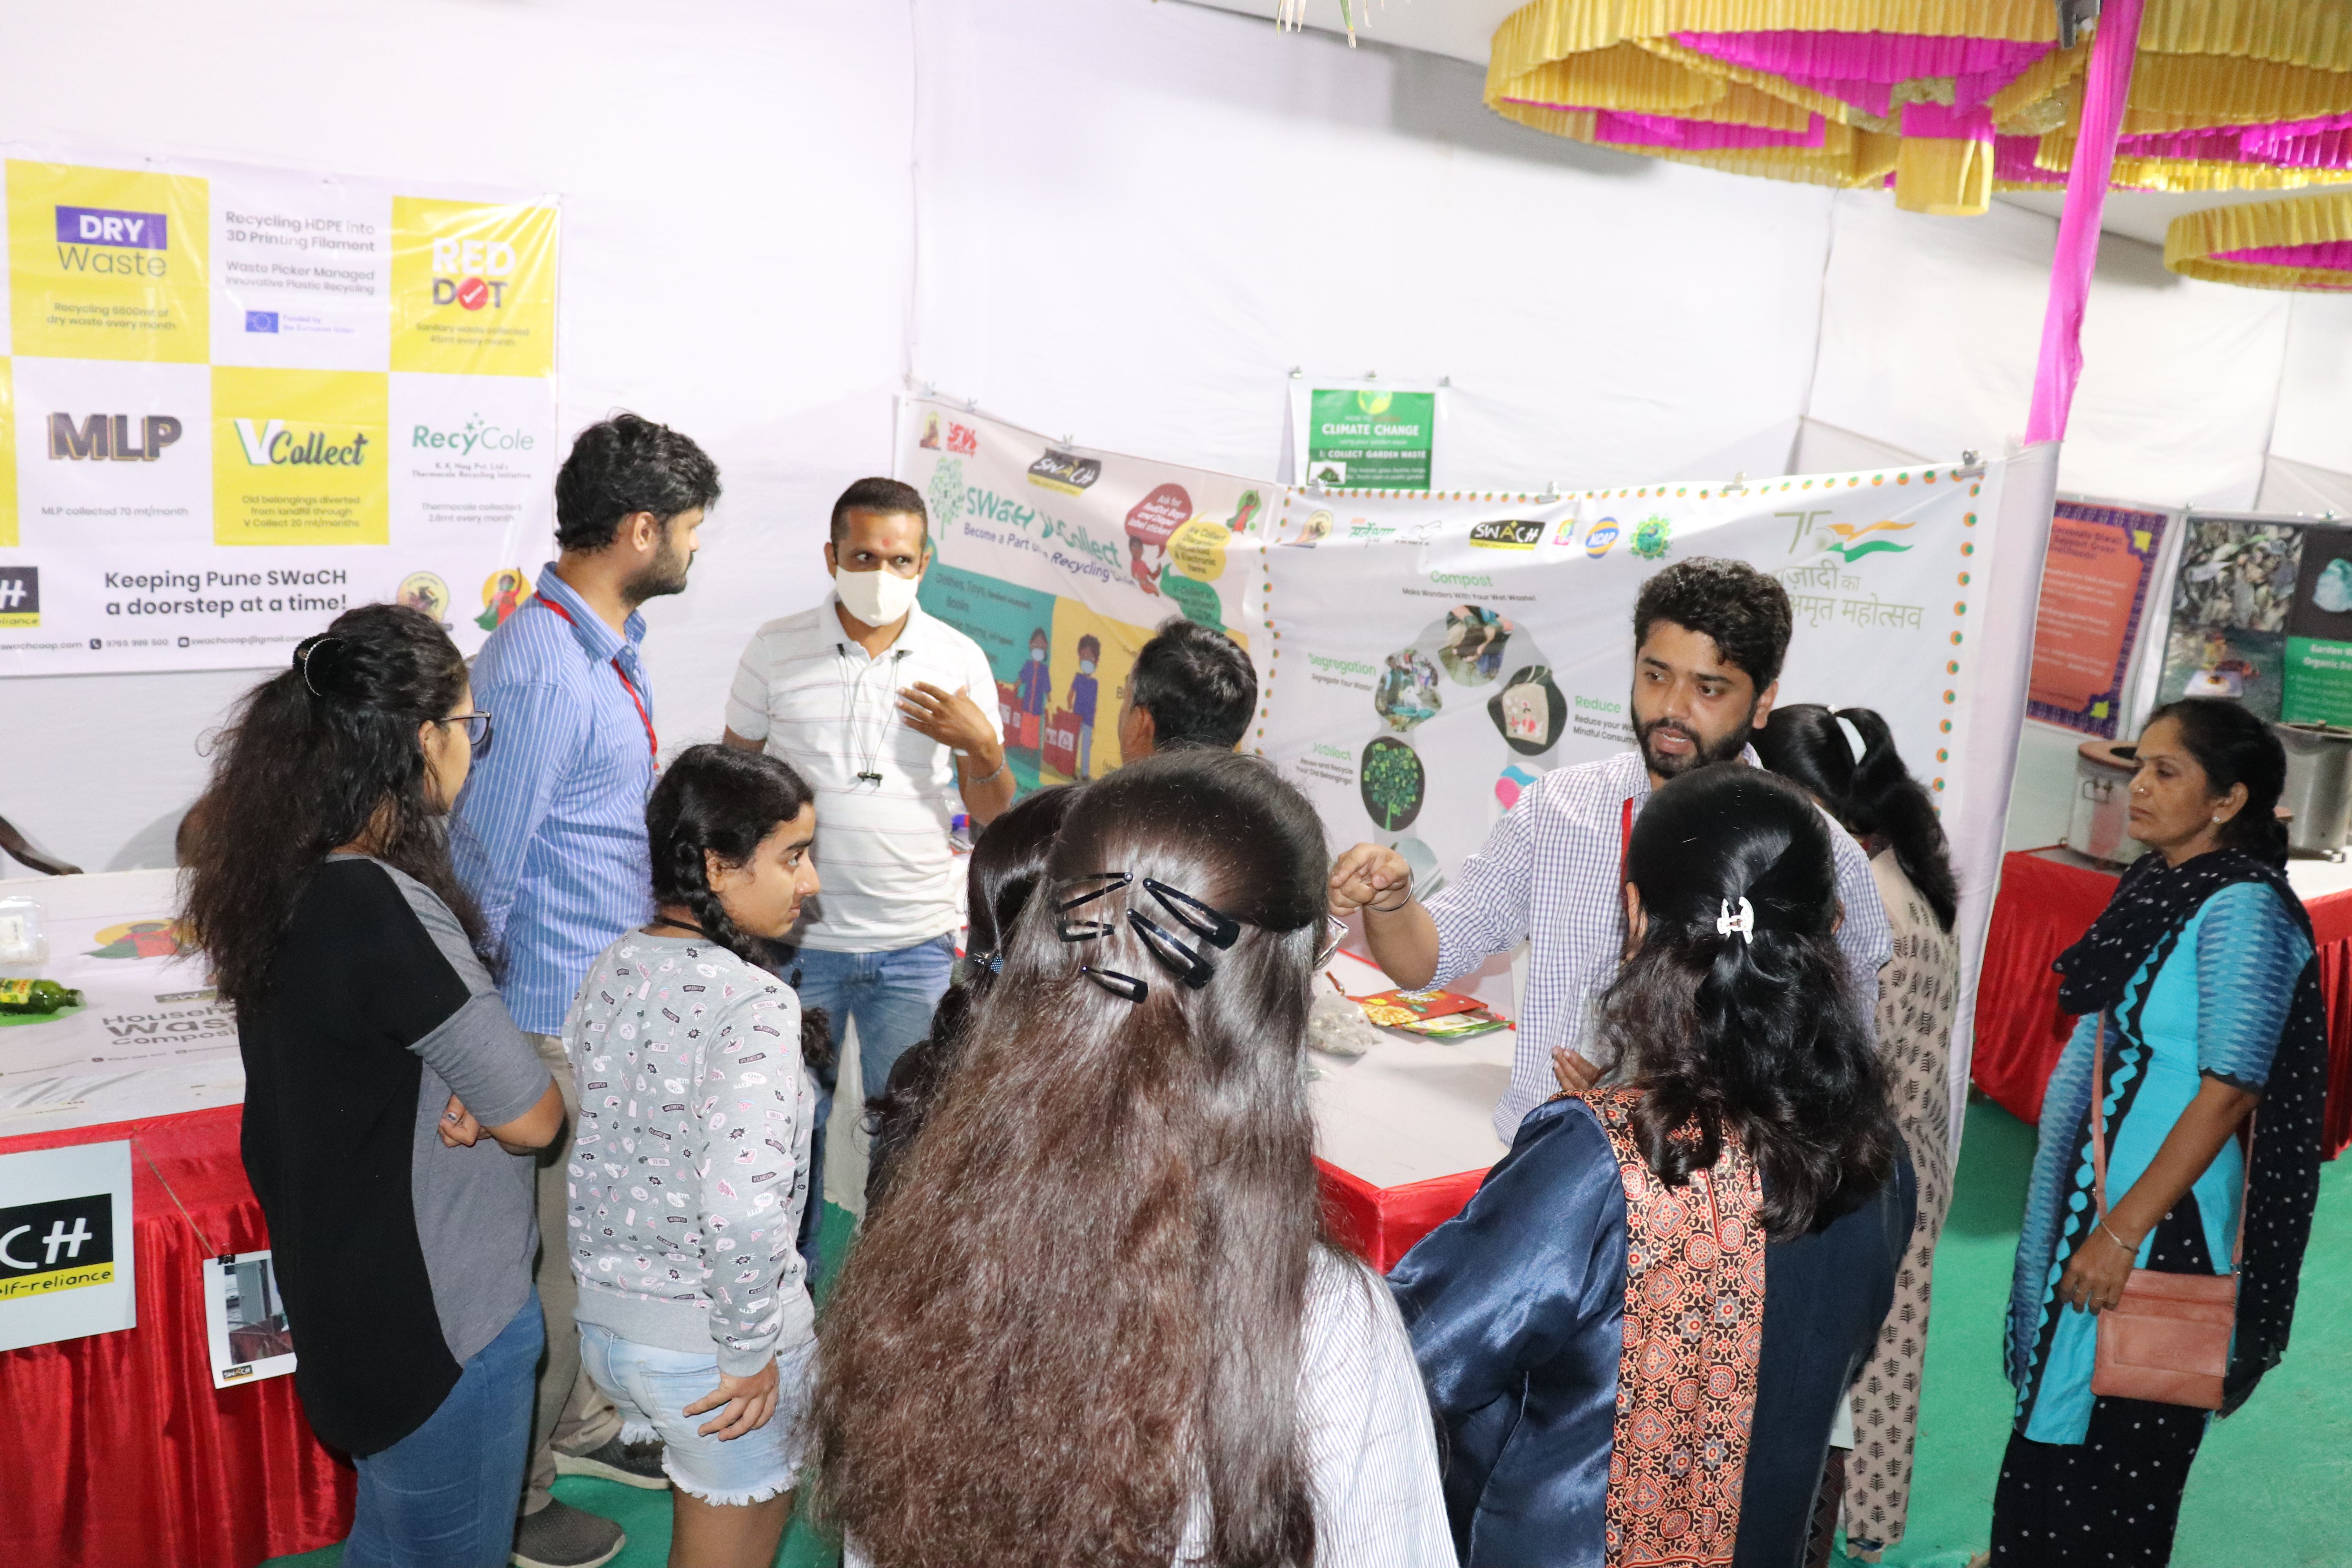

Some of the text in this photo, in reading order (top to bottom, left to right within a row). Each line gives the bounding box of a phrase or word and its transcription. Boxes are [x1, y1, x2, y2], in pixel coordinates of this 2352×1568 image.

[79, 214, 145, 243] DRY
[226, 211, 374, 235] Recycling HDPE into
[226, 230, 375, 251] 3D Printing Filament
[57, 245, 167, 277] Waste
[433, 237, 516, 276] RED
[226, 261, 374, 282] Waste Picker Managed
[225, 276, 374, 296] Innovative Plastic Recycling
[54, 303, 109, 316] Recycling
[283, 314, 310, 323] Funded
[47, 315, 176, 330] dry waste every month
[416, 323, 454, 332] Sanitary
[47, 412, 181, 461] MLP
[1321, 423, 1419, 437] CLIMATE CHANGE
[412, 425, 534, 456] RecyCole
[1328, 450, 1363, 458] COLLECT
[1366, 450, 1399, 459] GARDEN
[1401, 450, 1426, 459] WASTE
[242, 495, 360, 506] Old belongings diverted
[41, 505, 189, 517] MLP collected 70 mt/month
[251, 506, 352, 517] from landfill through
[456, 515, 481, 524] every
[484, 514, 515, 522] month
[243, 517, 359, 528] V Collect 20 mt/months
[964, 522, 1030, 550] Become a Part
[1588, 532, 1615, 546] NCAP
[1051, 552, 1110, 582] Recycling
[105, 570, 346, 592] Keeping Pune SWaCH
[1431, 570, 1493, 588] Compost
[1402, 588, 1421, 596] Make
[1422, 590, 1452, 599] Wonders
[106, 593, 347, 618] a doorstep at a time!
[1842, 593, 1925, 630] महोत्सव
[1308, 652, 1376, 676] Segregation
[1312, 673, 1339, 686] Segregate
[1341, 679, 1353, 688] Your
[1575, 695, 1621, 713] Reduce
[1574, 714, 1602, 726] Reduce
[1603, 719, 1620, 730] your
[1573, 726, 1640, 746] Mindful Consump
[1300, 757, 1353, 775] Reuse and Recycle
[107, 1018, 229, 1037] Was
